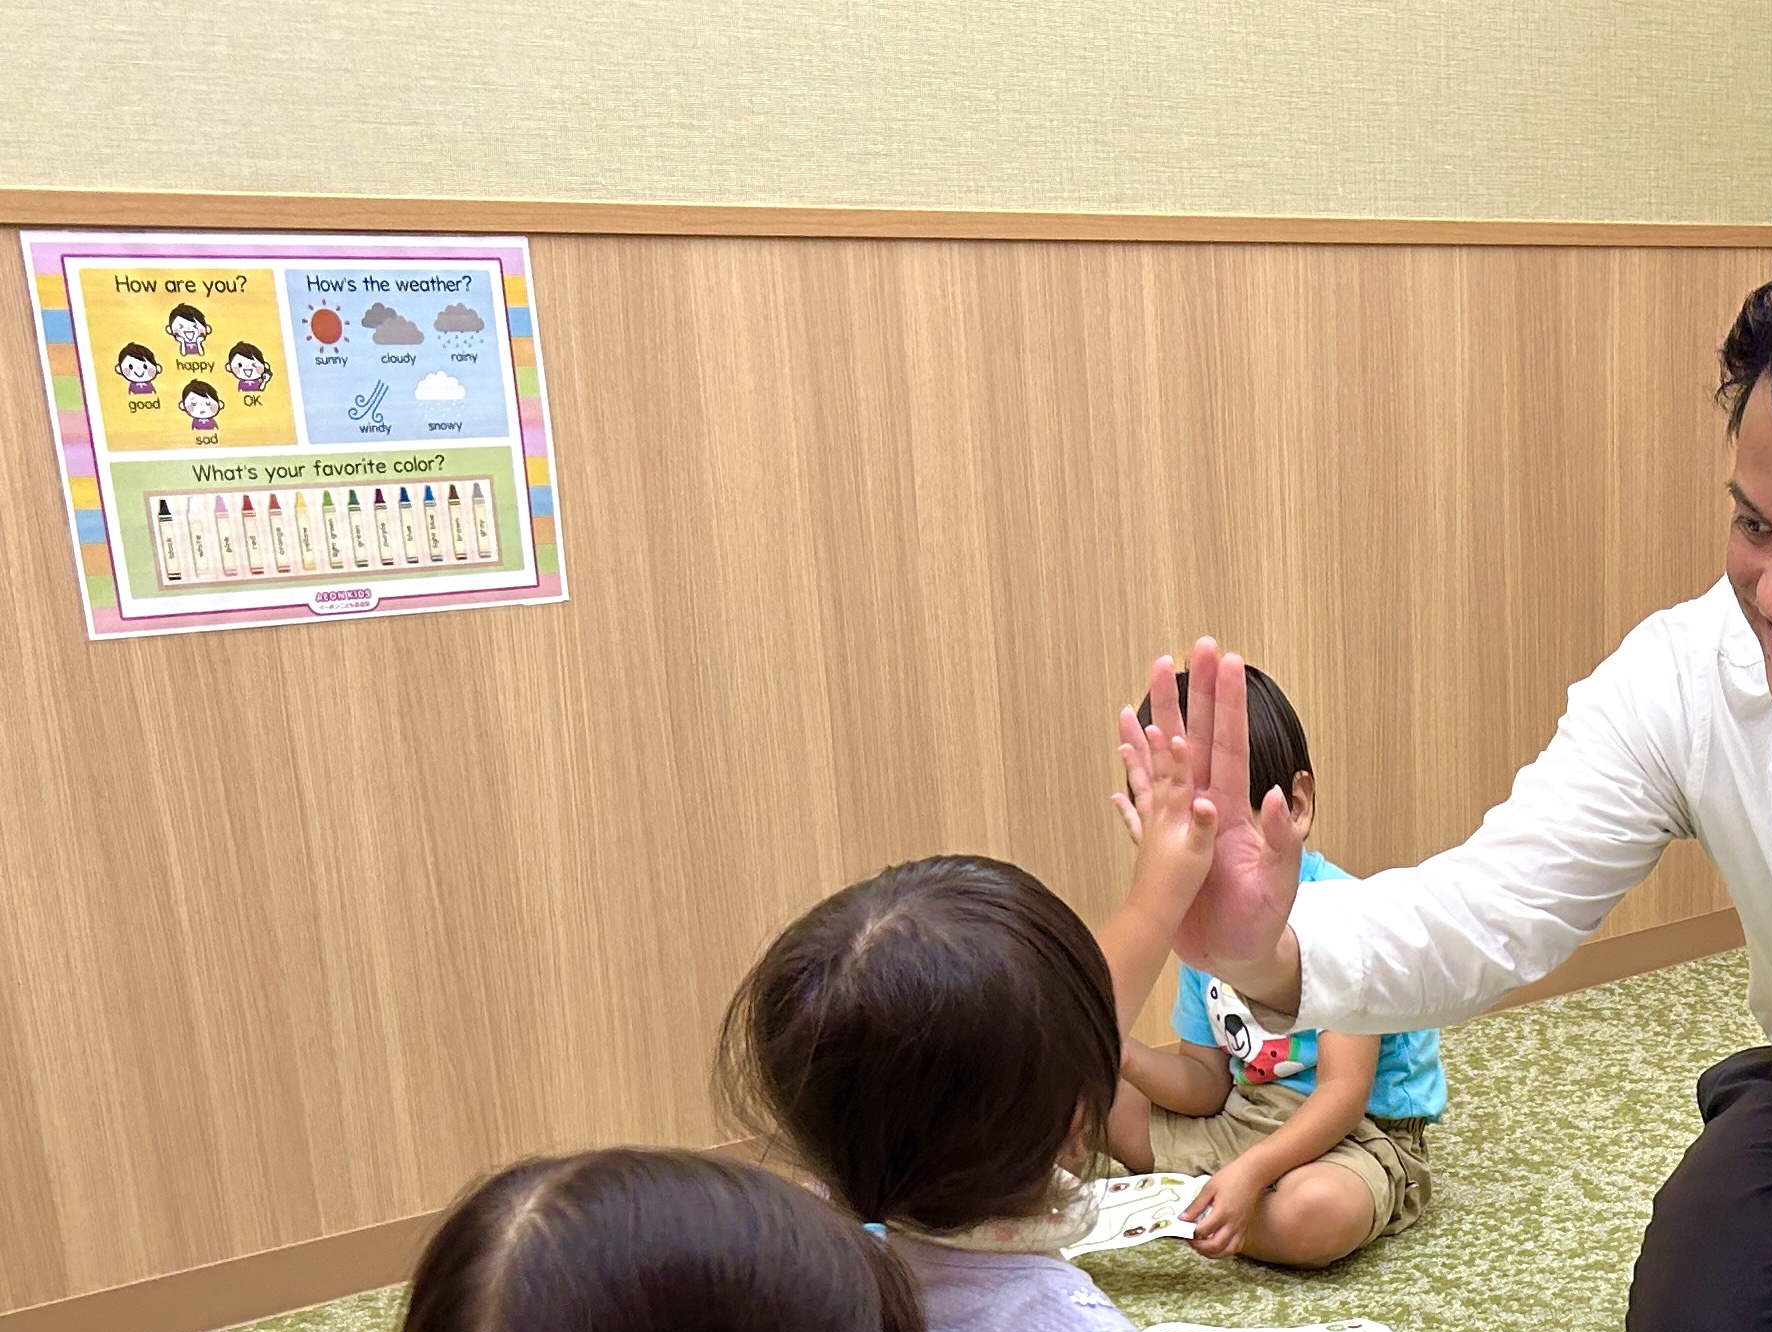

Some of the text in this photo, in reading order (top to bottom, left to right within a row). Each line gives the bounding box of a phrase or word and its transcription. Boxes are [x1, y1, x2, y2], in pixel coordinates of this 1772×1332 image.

[115, 275, 247, 298] How are you?
[306, 275, 472, 294] How's the weather?
[176, 359, 215, 375] happy
[315, 350, 479, 368] sunny cloudy rainy
[128, 398, 161, 414] good
[243, 394, 263, 408] OK
[359, 419, 463, 436] windy snowy
[196, 432, 219, 446] sad
[192, 454, 445, 483] What's your favorite color?
[276, 527, 285, 556] orange
[314, 588, 373, 604] AEON KIDS
